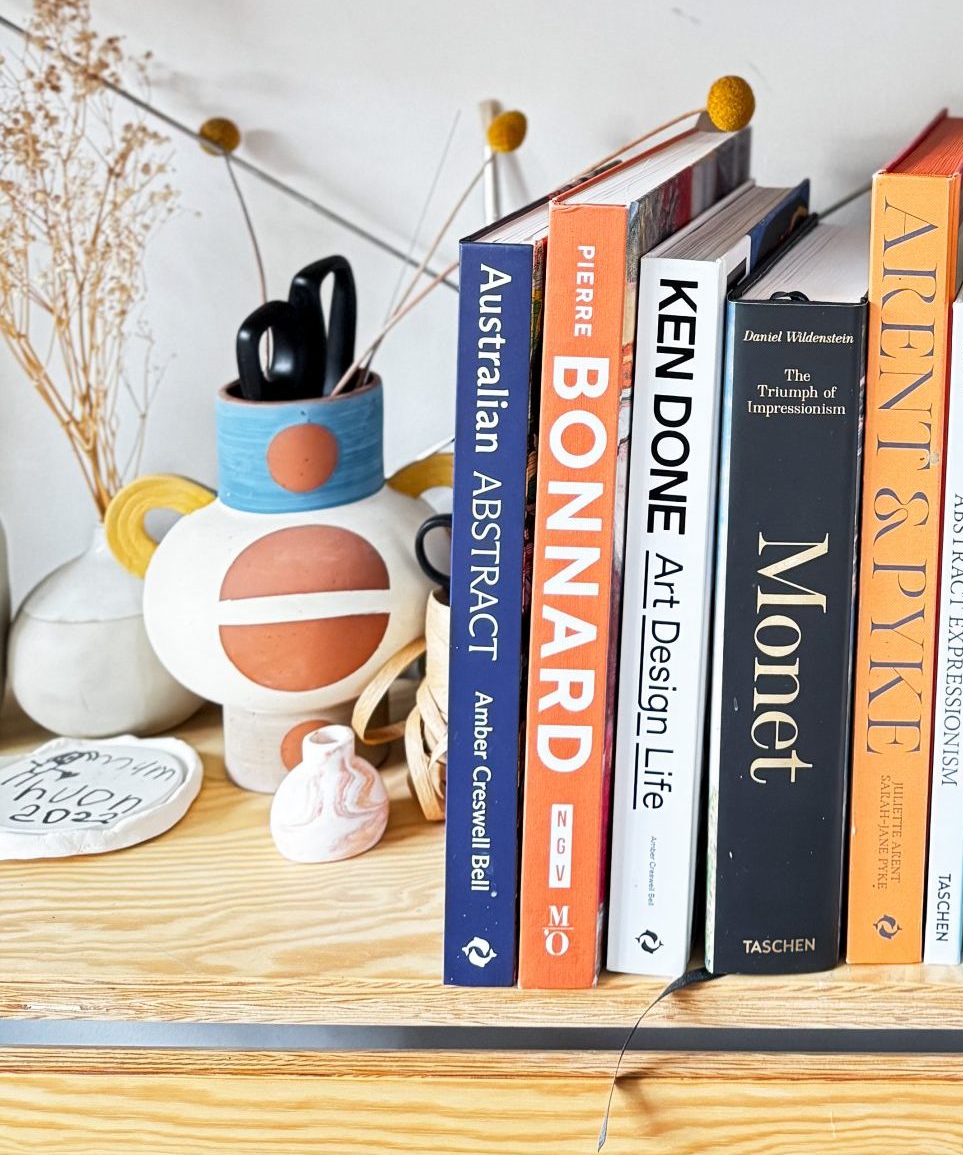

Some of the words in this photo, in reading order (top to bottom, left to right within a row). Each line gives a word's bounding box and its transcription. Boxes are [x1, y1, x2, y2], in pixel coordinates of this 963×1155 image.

[573, 245, 596, 337] PIERRE
[474, 262, 512, 453] Australian
[655, 278, 699, 381] KEN
[743, 329, 782, 343] Daniel
[785, 330, 854, 344] Wildenstein
[876, 196, 939, 472] ARENT
[747, 400, 846, 417] Impressionism
[757, 384, 819, 402] Triumph
[823, 386, 838, 399] of
[784, 368, 811, 382] The
[646, 394, 693, 535] DONE
[873, 487, 930, 545] &
[467, 470, 503, 661] ABSTRACT
[536, 355, 610, 773] BONNARD
[652, 552, 684, 610] Art
[639, 619, 682, 735] Design
[749, 531, 829, 785] Monet
[866, 557, 928, 755] PYKE
[472, 690, 494, 757] Amber
[470, 769, 492, 850] Creswell
[642, 748, 674, 811] Life
[877, 775, 891, 852] SARAH-JANE
[891, 781, 904, 839] JULIETTE
[470, 854, 490, 891] Bell
[877, 853, 889, 890] PYKE
[890, 841, 902, 884] ARENT
[935, 873, 952, 943] TASCHEN
[742, 938, 816, 954] TASCHEN
